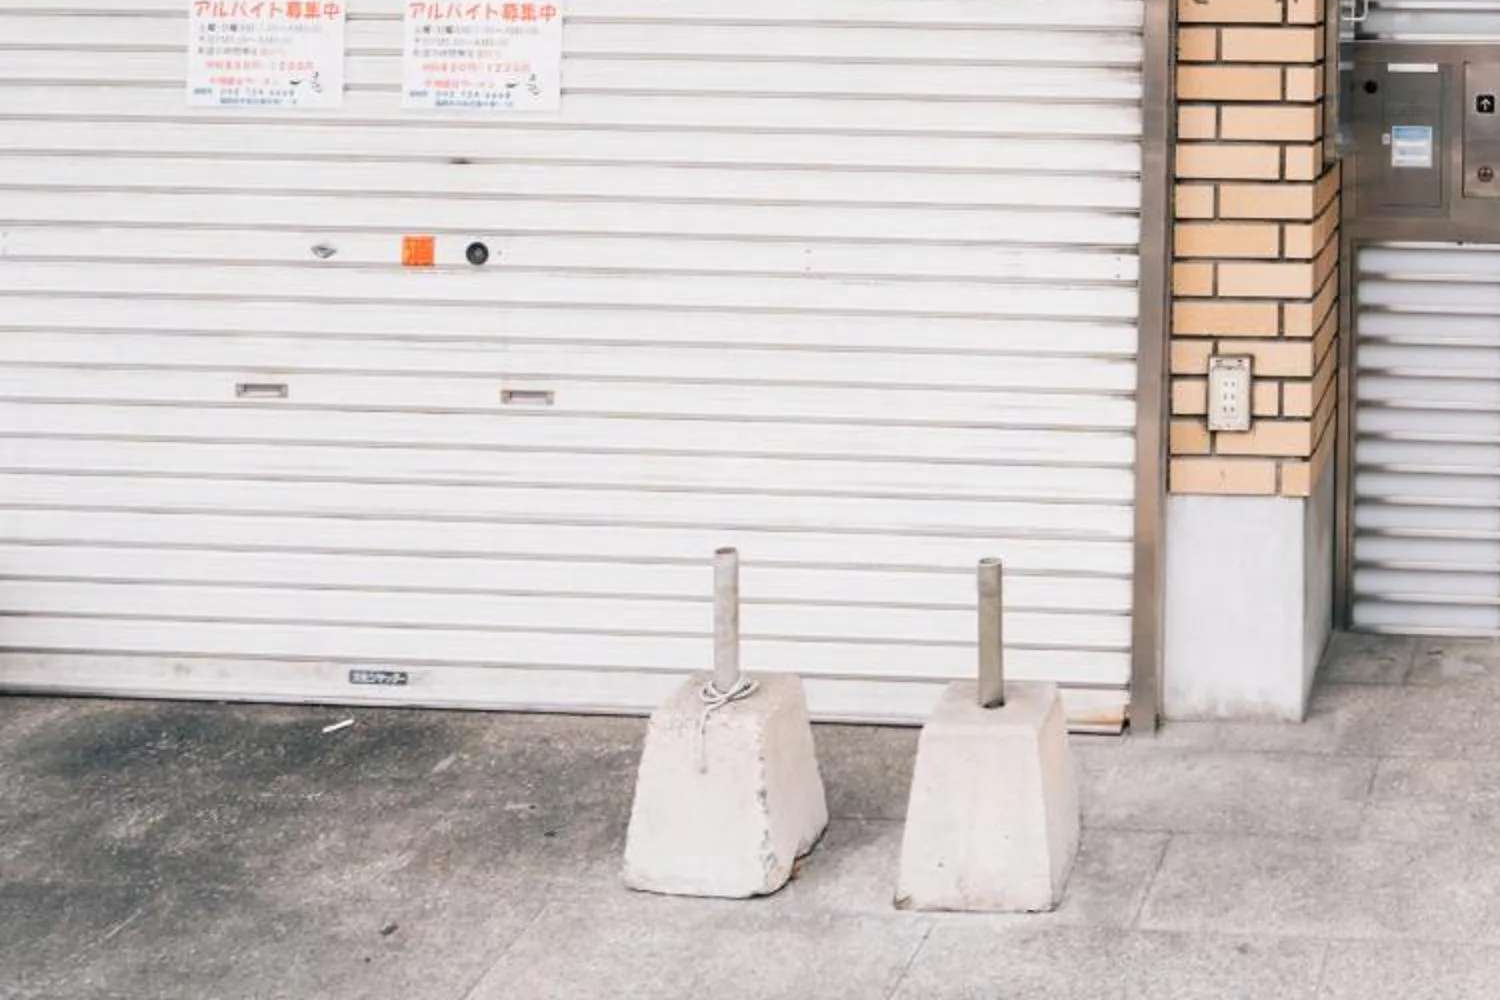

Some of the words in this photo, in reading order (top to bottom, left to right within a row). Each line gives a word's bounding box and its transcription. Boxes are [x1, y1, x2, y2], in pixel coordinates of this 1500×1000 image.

[193, 0, 342, 20] アルバイト募集中
[408, 1, 557, 21] アルバイト募集中
